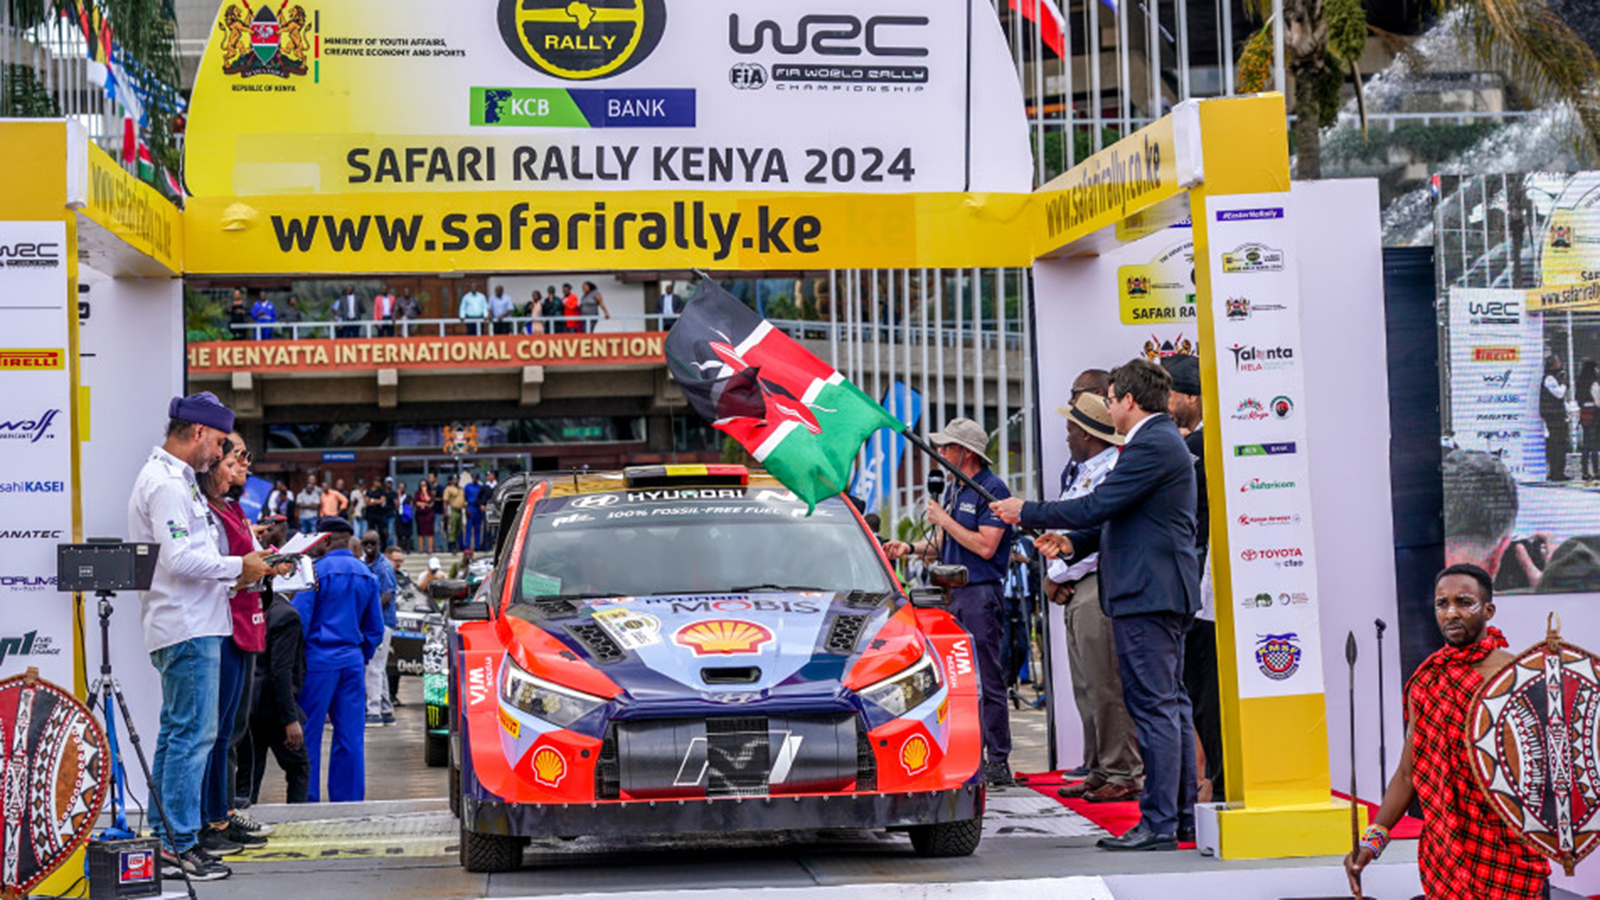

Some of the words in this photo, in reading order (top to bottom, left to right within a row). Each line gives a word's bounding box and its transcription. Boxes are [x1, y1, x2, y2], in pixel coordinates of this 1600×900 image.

[729, 13, 929, 57] WRC
[324, 38, 362, 46] MINISTRY
[365, 38, 377, 46] OF
[410, 39, 447, 47] AFFAIRS,
[544, 35, 617, 50] RALLY
[324, 48, 364, 56] CREATIVE
[366, 49, 410, 57] ECONOMY
[412, 49, 432, 57] AND
[433, 49, 466, 57] SPORTS
[776, 68, 800, 77] FIA
[804, 69, 863, 79] WORLD
[868, 70, 924, 79] RALLY
[264, 84, 273, 92] OF
[274, 84, 296, 92] KENYA
[776, 83, 924, 92] CHAMPIONSHIP
[511, 98, 549, 116] KCB
[607, 99, 666, 117] BANK
[347, 147, 495, 183] SAFARI
[513, 146, 638, 182] RALLY
[653, 147, 789, 183] KENYA
[804, 148, 916, 183] 2024
[1045, 133, 1161, 240] www.safarirally.co.ke
[271, 201, 822, 261] www.safarirally.ke
[1132, 307, 1176, 320] SAFARI
[1469, 301, 1519, 316] WRC
[0, 351, 58, 366] IRELLI
[187, 346, 211, 367] HE
[216, 344, 329, 367] KENYATTA
[334, 340, 511, 365] INTERNATIONAL
[516, 336, 662, 361] CONVENTION
[1250, 481, 1295, 490] Safaricom
[627, 488, 743, 501] HYUNDAI
[607, 509, 648, 520] 100%
[651, 505, 742, 516] FOSSIL-FREE
[744, 506, 781, 515] FUEL
[0, 530, 61, 538] ANATEC
[1259, 548, 1302, 559] TOYOTA
[0, 576, 57, 585] ORUM8
[671, 600, 821, 614] MOBIS
